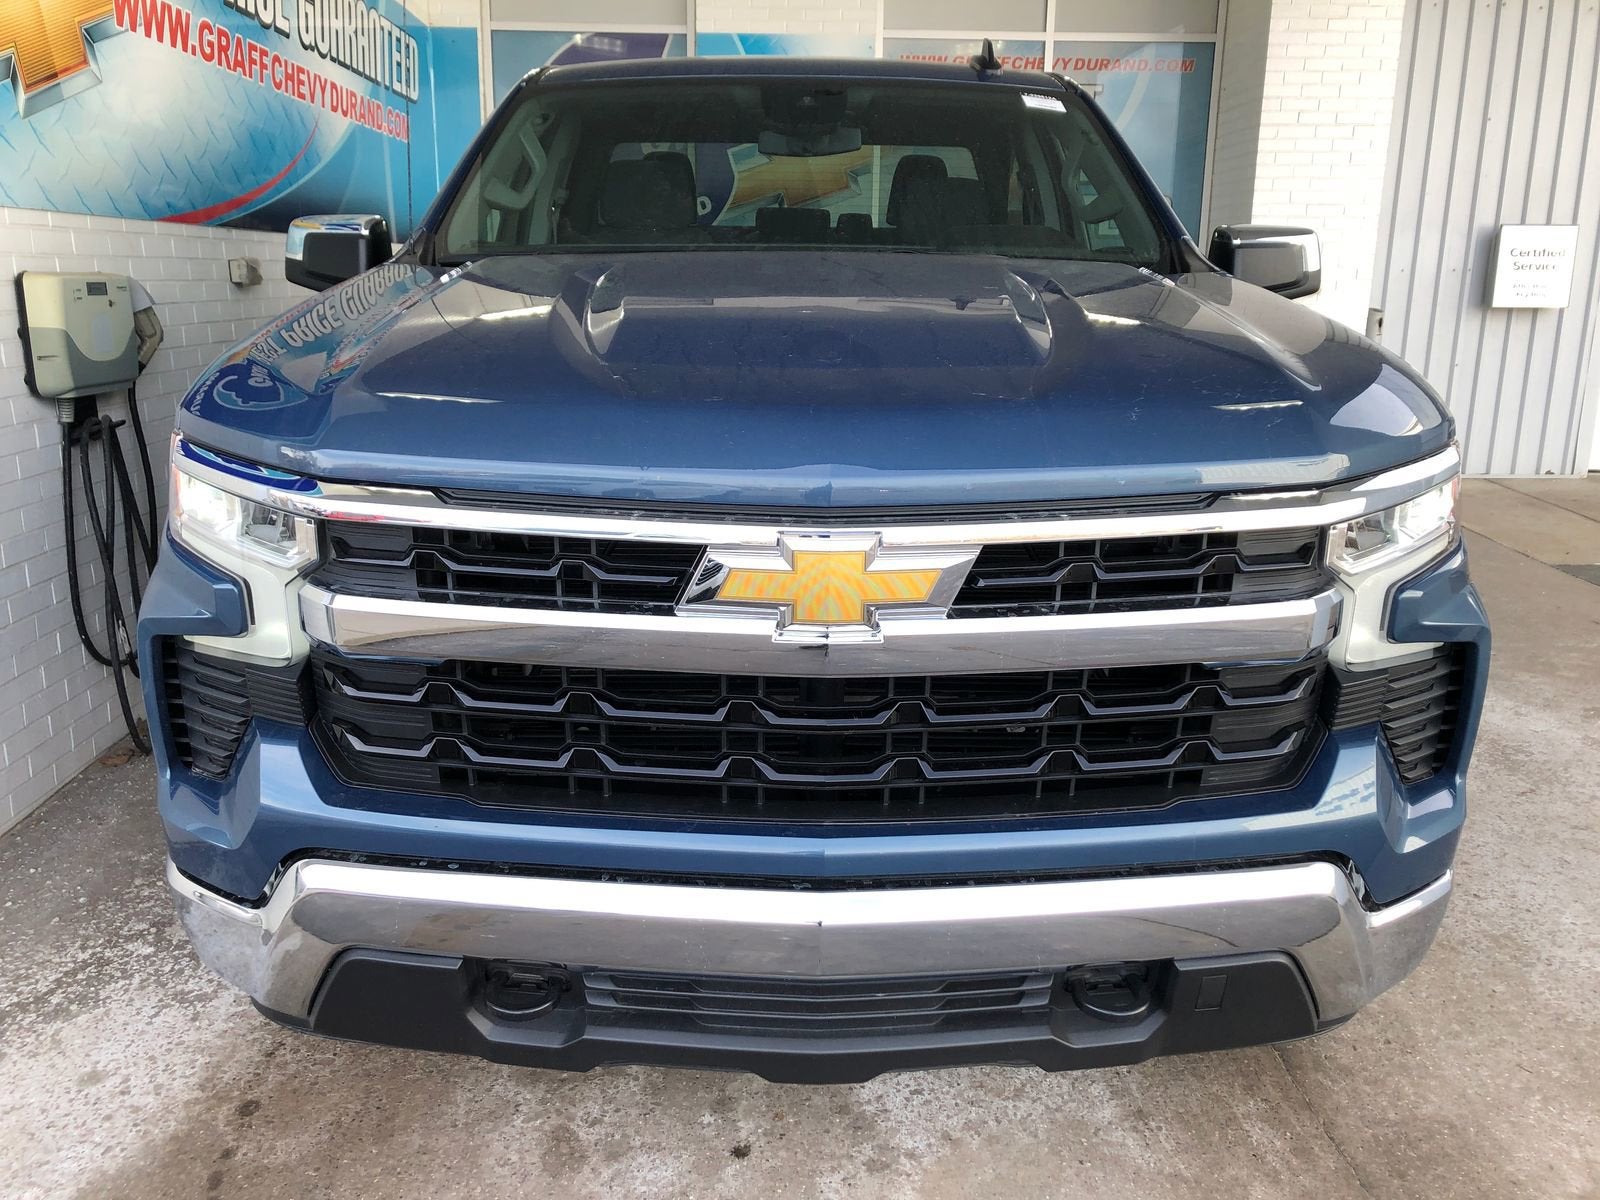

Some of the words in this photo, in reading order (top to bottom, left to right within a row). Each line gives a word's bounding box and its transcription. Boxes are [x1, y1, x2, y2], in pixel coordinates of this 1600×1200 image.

[297, 0, 419, 104] GUARANTEED
[1510, 247, 1566, 257] Certified
[1513, 260, 1557, 271] Service
